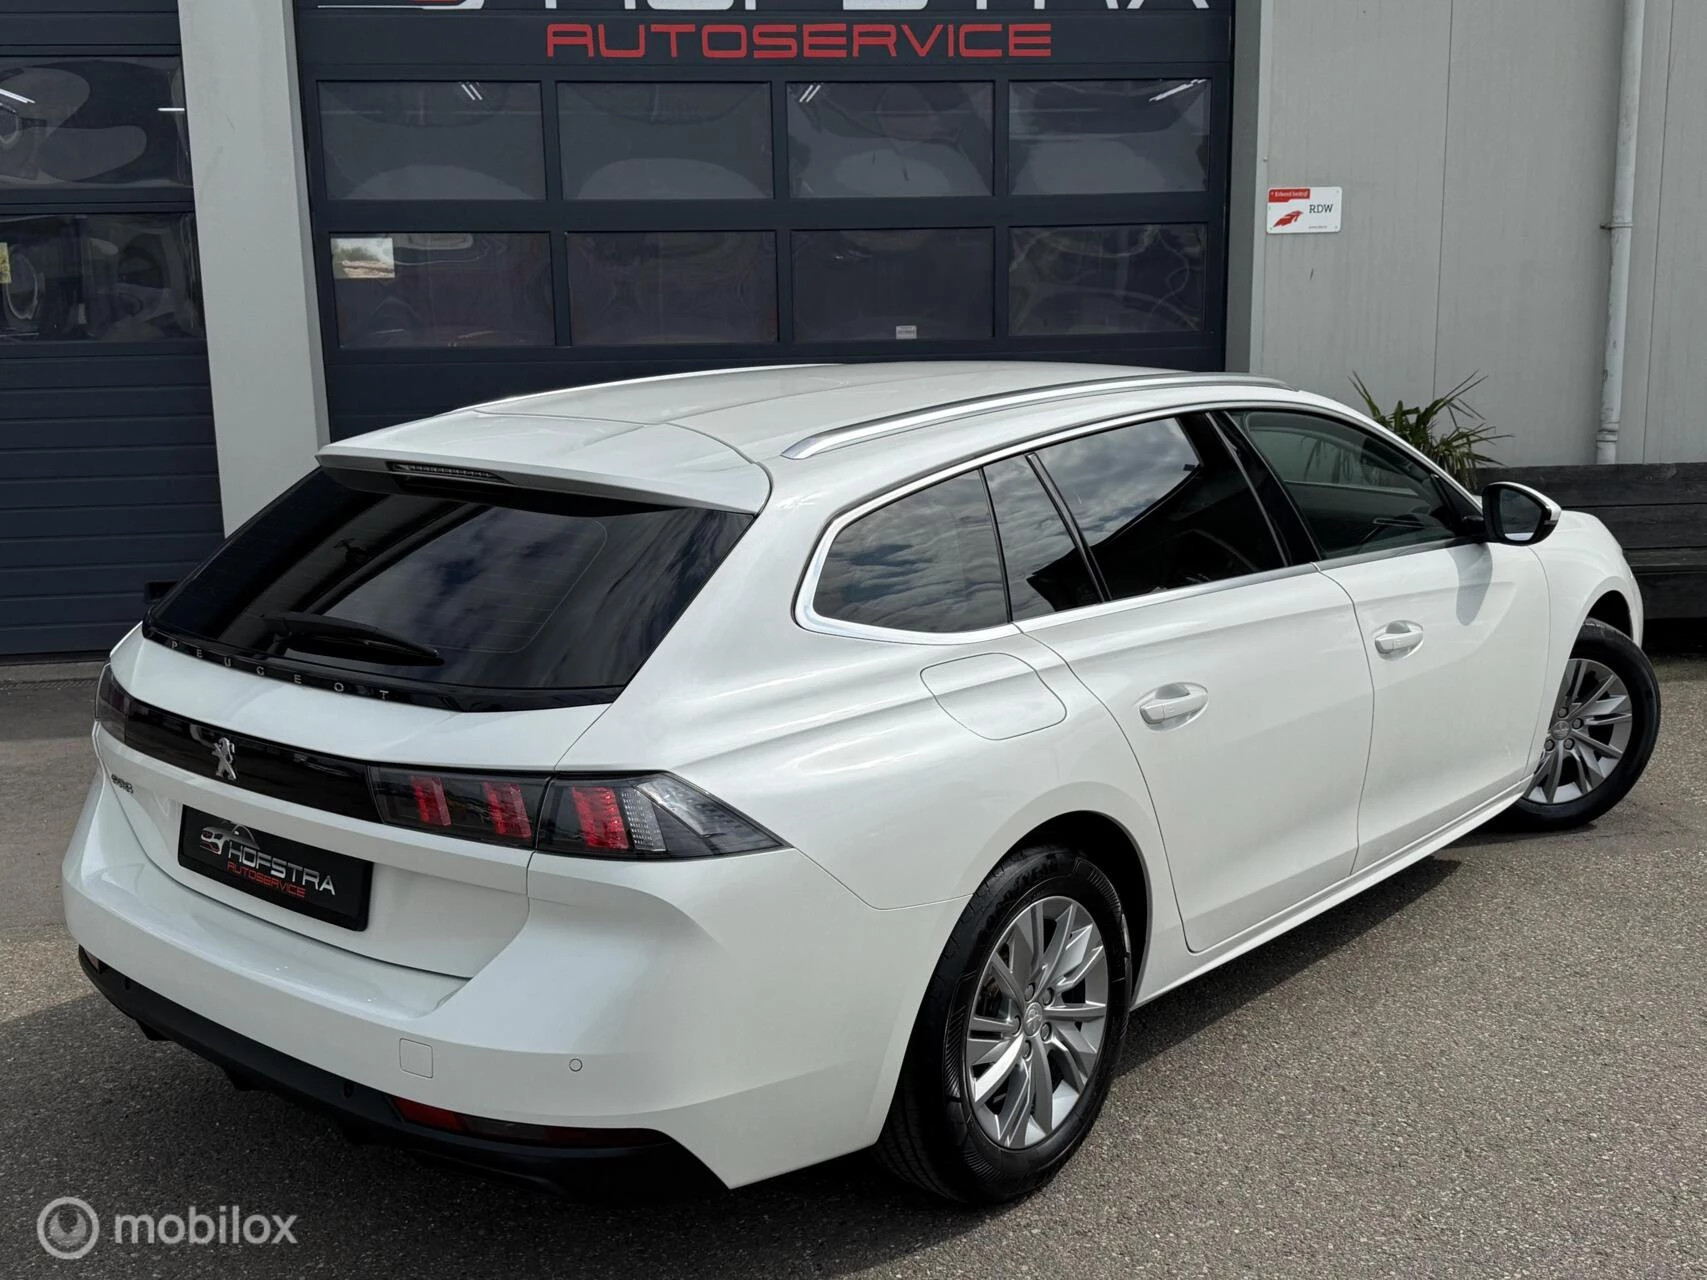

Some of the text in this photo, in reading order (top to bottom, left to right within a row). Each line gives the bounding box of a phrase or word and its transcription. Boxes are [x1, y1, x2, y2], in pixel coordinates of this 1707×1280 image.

[546, 23, 1052, 59] AUTOSERVICE
[1309, 204, 1333, 214] RDW
[171, 640, 390, 700] PEUGEOT
[226, 861, 307, 898] AUTOSERVICE
[228, 840, 336, 896] HOFSTRA
